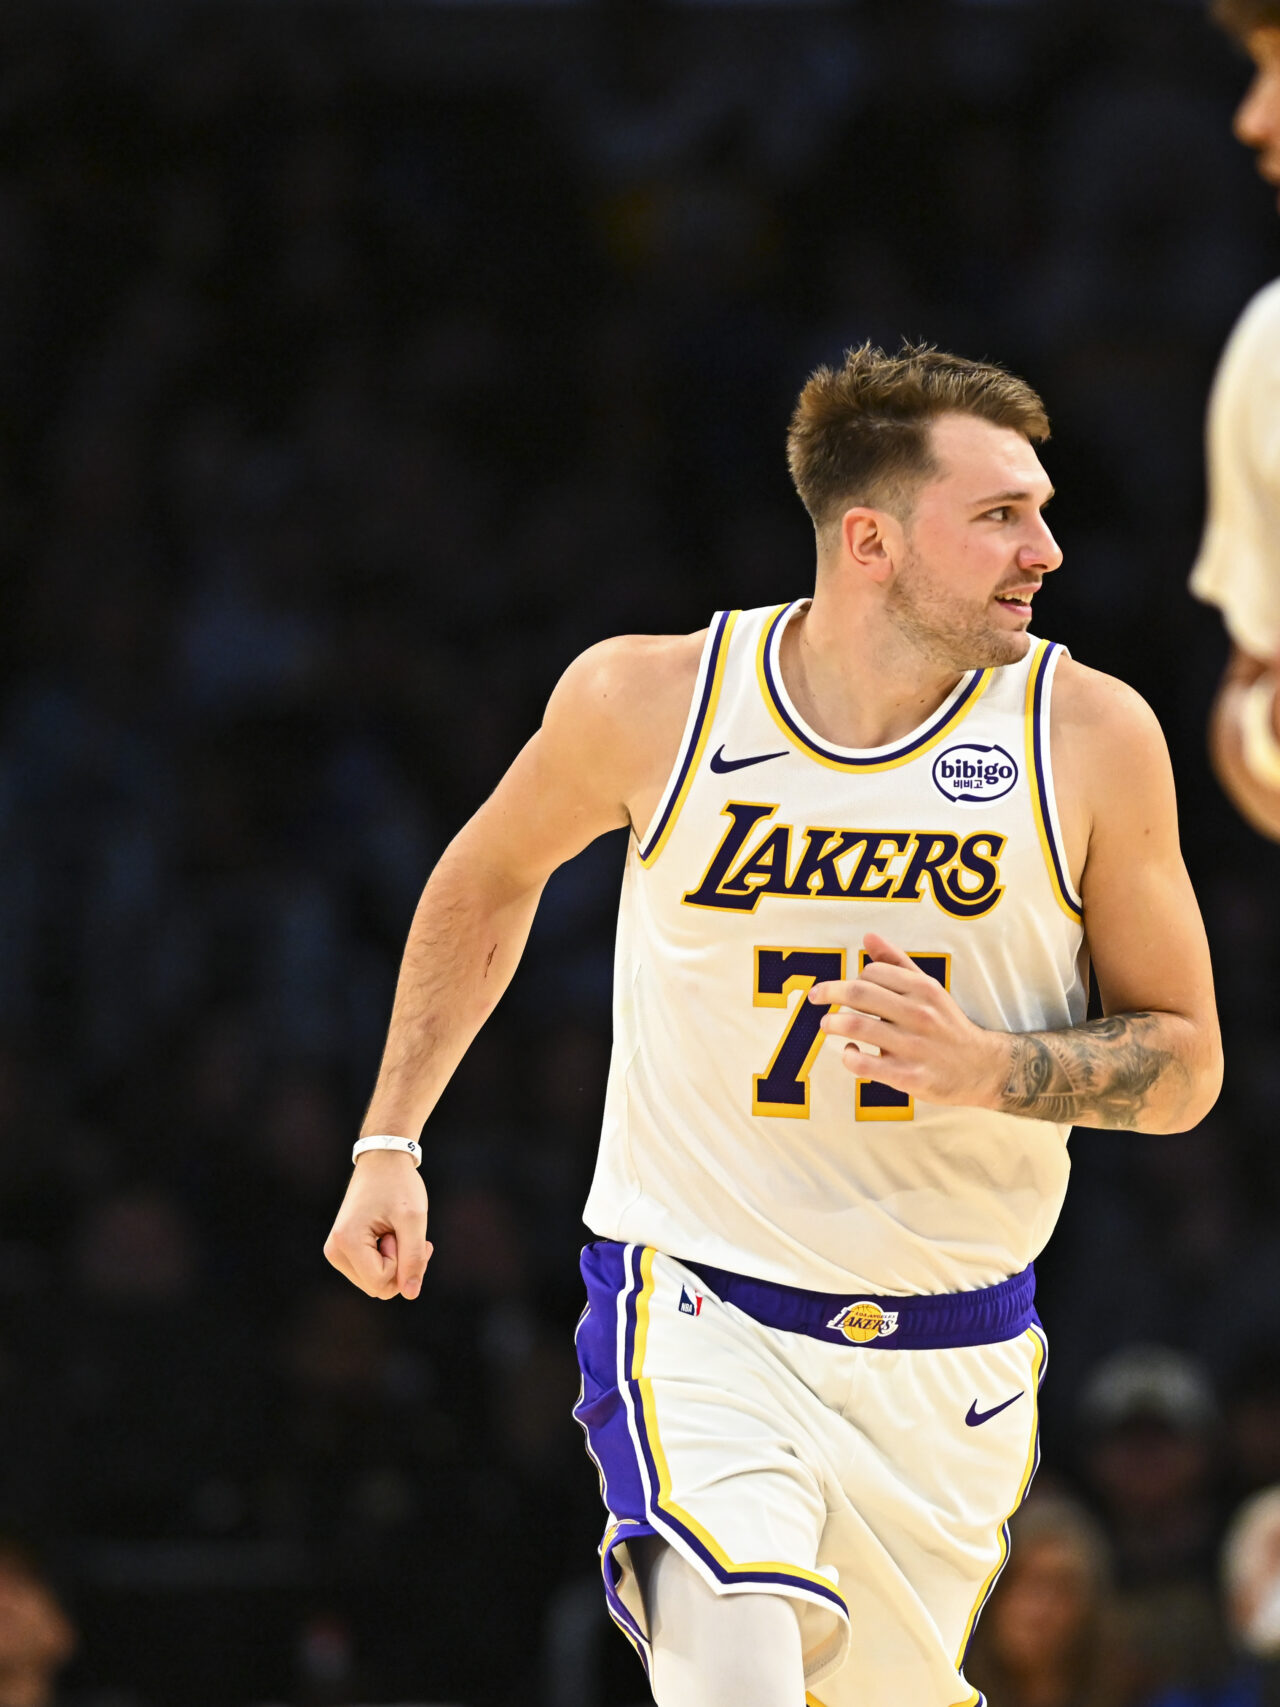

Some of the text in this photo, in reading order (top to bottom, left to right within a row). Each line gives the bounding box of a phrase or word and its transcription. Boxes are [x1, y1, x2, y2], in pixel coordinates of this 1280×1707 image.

[941, 759, 1013, 785] bibigo
[953, 779, 984, 789] 비비고
[682, 800, 1008, 921] LAKERS
[831, 1309, 896, 1335] LAKERS
